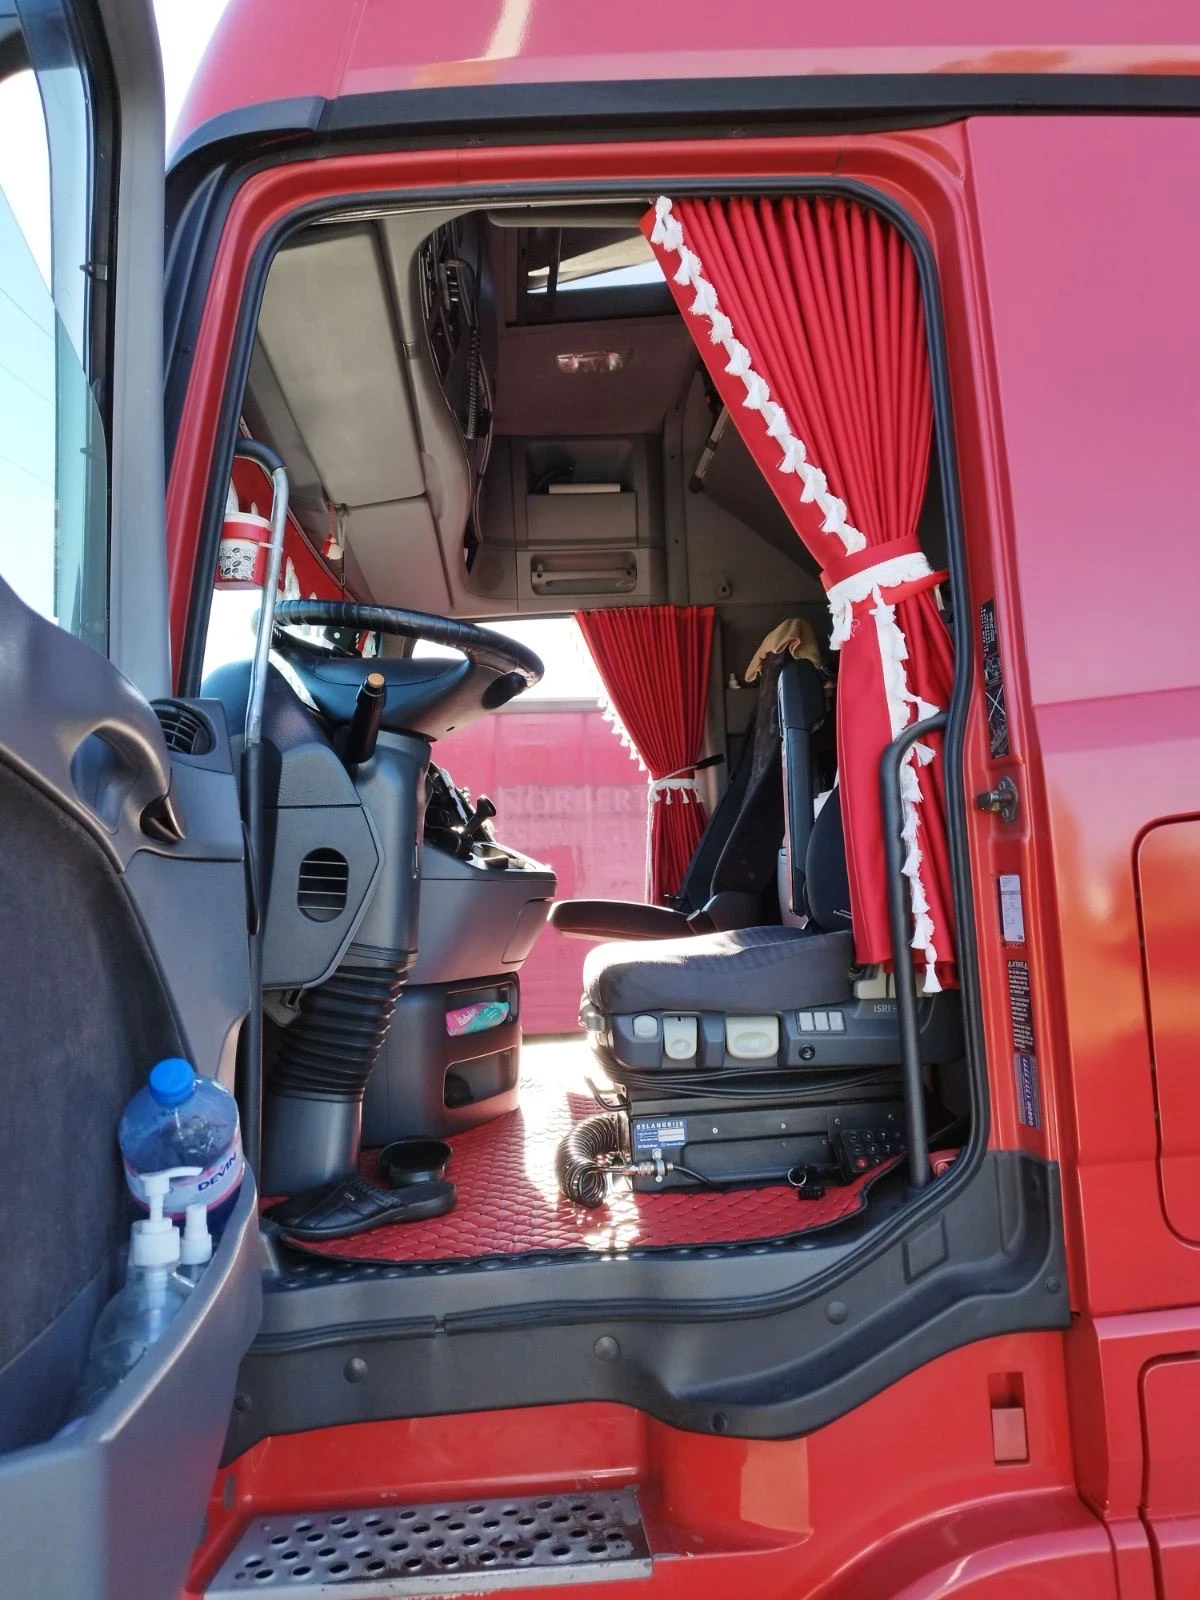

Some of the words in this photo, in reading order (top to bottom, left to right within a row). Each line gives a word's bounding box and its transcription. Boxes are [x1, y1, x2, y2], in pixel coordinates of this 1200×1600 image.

[874, 1003, 891, 1013] ISRI
[636, 1121, 685, 1130] BELANGRIJK
[198, 1152, 237, 1191] DEVIN
